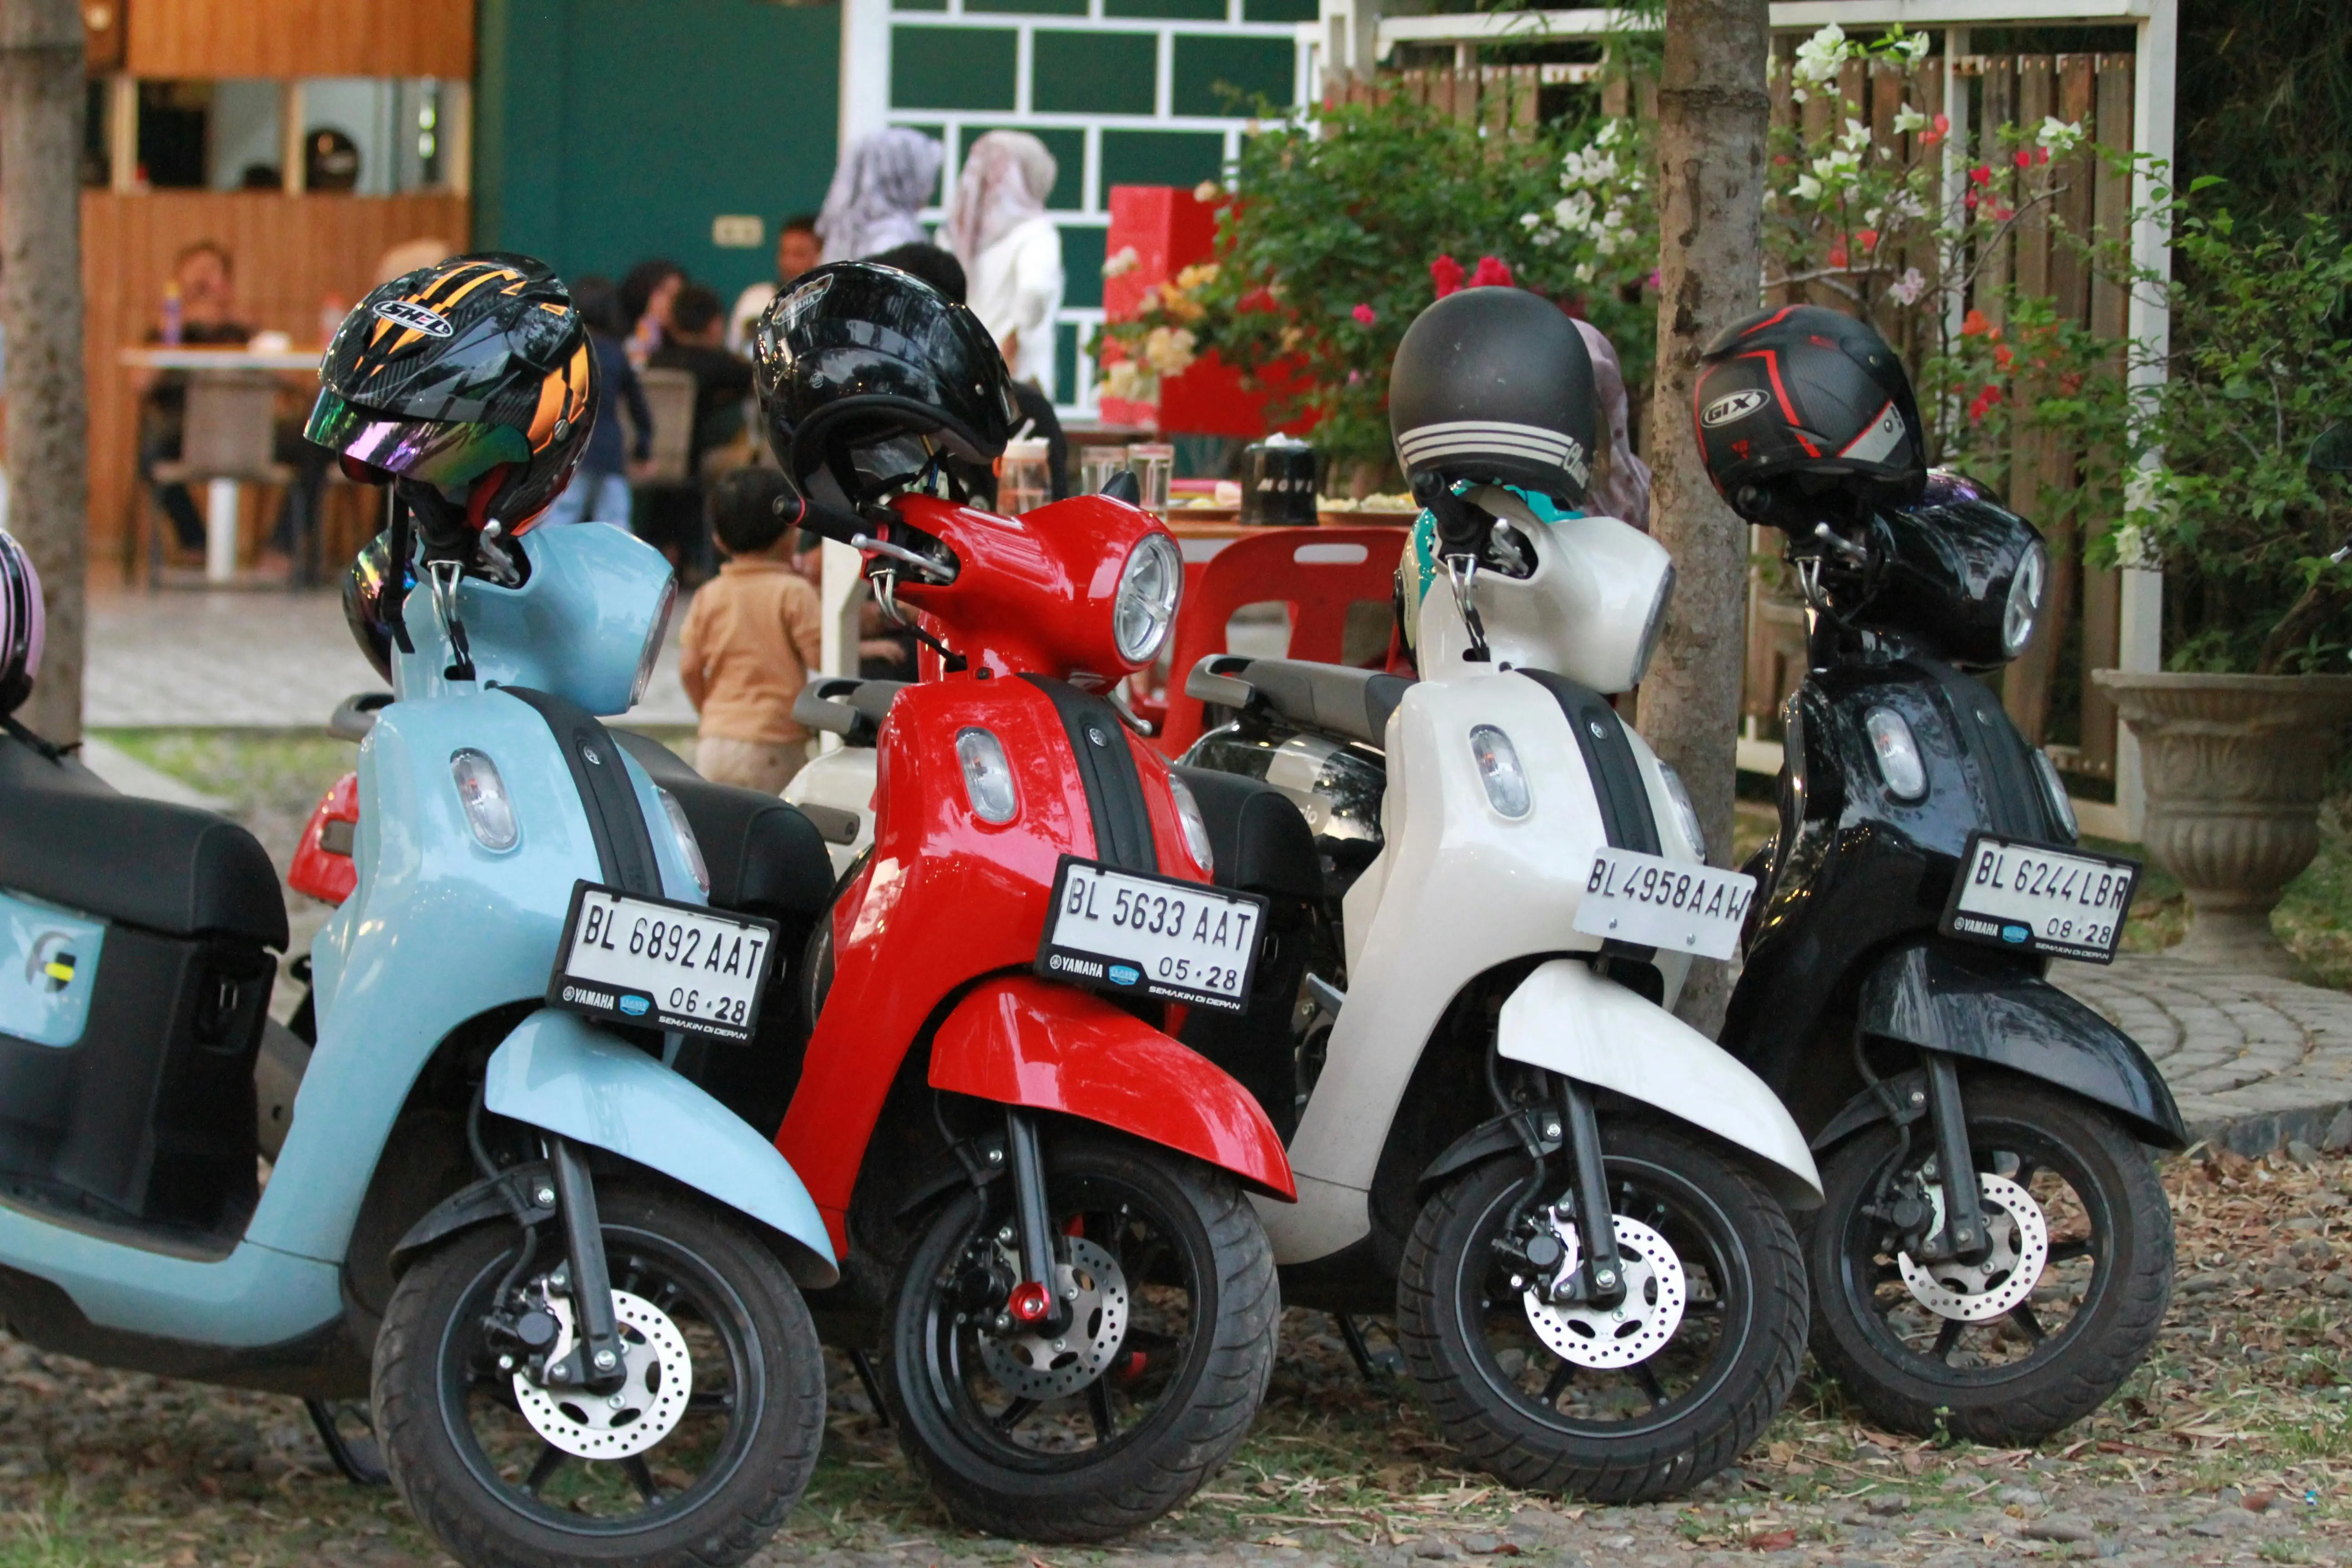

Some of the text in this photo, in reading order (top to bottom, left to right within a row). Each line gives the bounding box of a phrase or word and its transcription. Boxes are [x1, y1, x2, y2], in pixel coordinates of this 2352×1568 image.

[1587, 859, 1615, 898] BL
[1975, 851, 2003, 888] BL
[1067, 877, 1250, 951] BL 5633 AAT
[1965, 918, 1998, 936] YAMAHA
[583, 905, 763, 979] BL 6892 AAT
[2035, 942, 2072, 955] SEMAKIN
[1063, 956, 1102, 978] YAMAHA
[574, 988, 614, 1010] YAMAHA
[1148, 985, 1240, 1010] SEMAKIN DI DEPAN
[658, 1015, 748, 1040] SEMAKIN DI DEPAN
